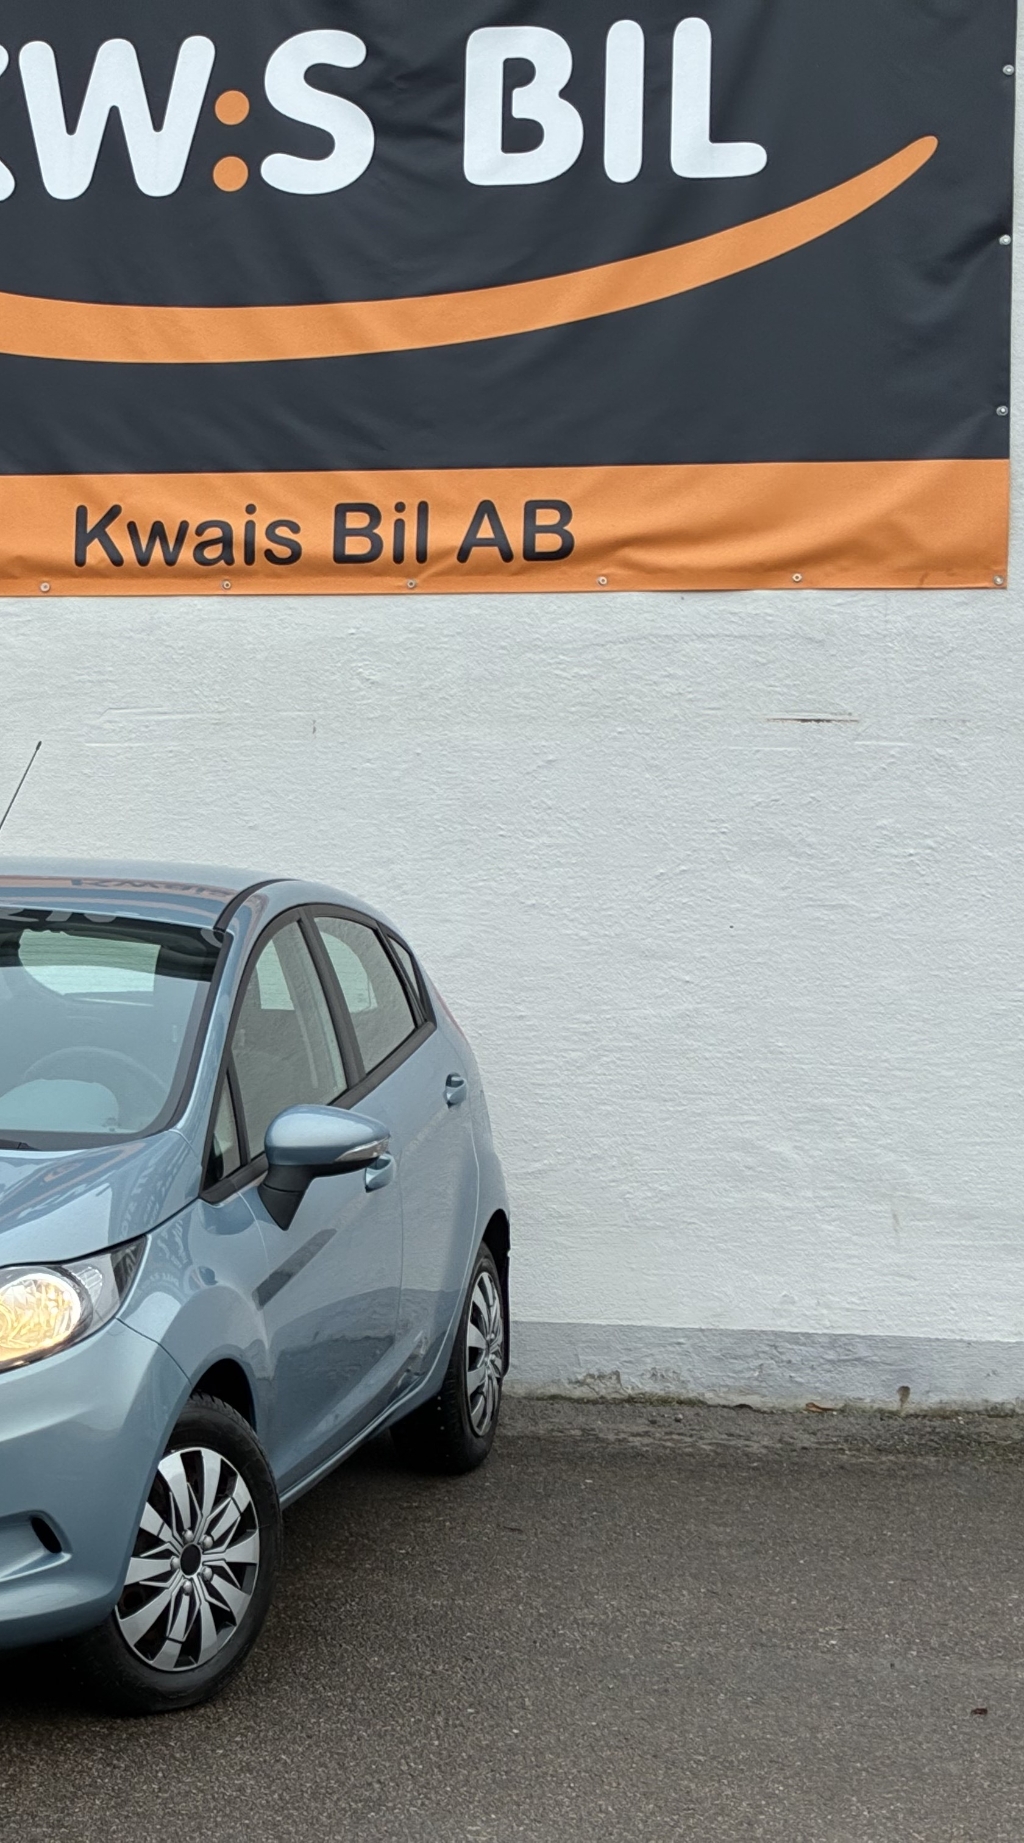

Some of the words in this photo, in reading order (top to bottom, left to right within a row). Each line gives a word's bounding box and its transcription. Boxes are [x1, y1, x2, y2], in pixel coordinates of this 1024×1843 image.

[463, 17, 768, 186] BIL
[74, 503, 303, 568] Kwais
[332, 500, 429, 566] Bil
[456, 499, 575, 564] AB
